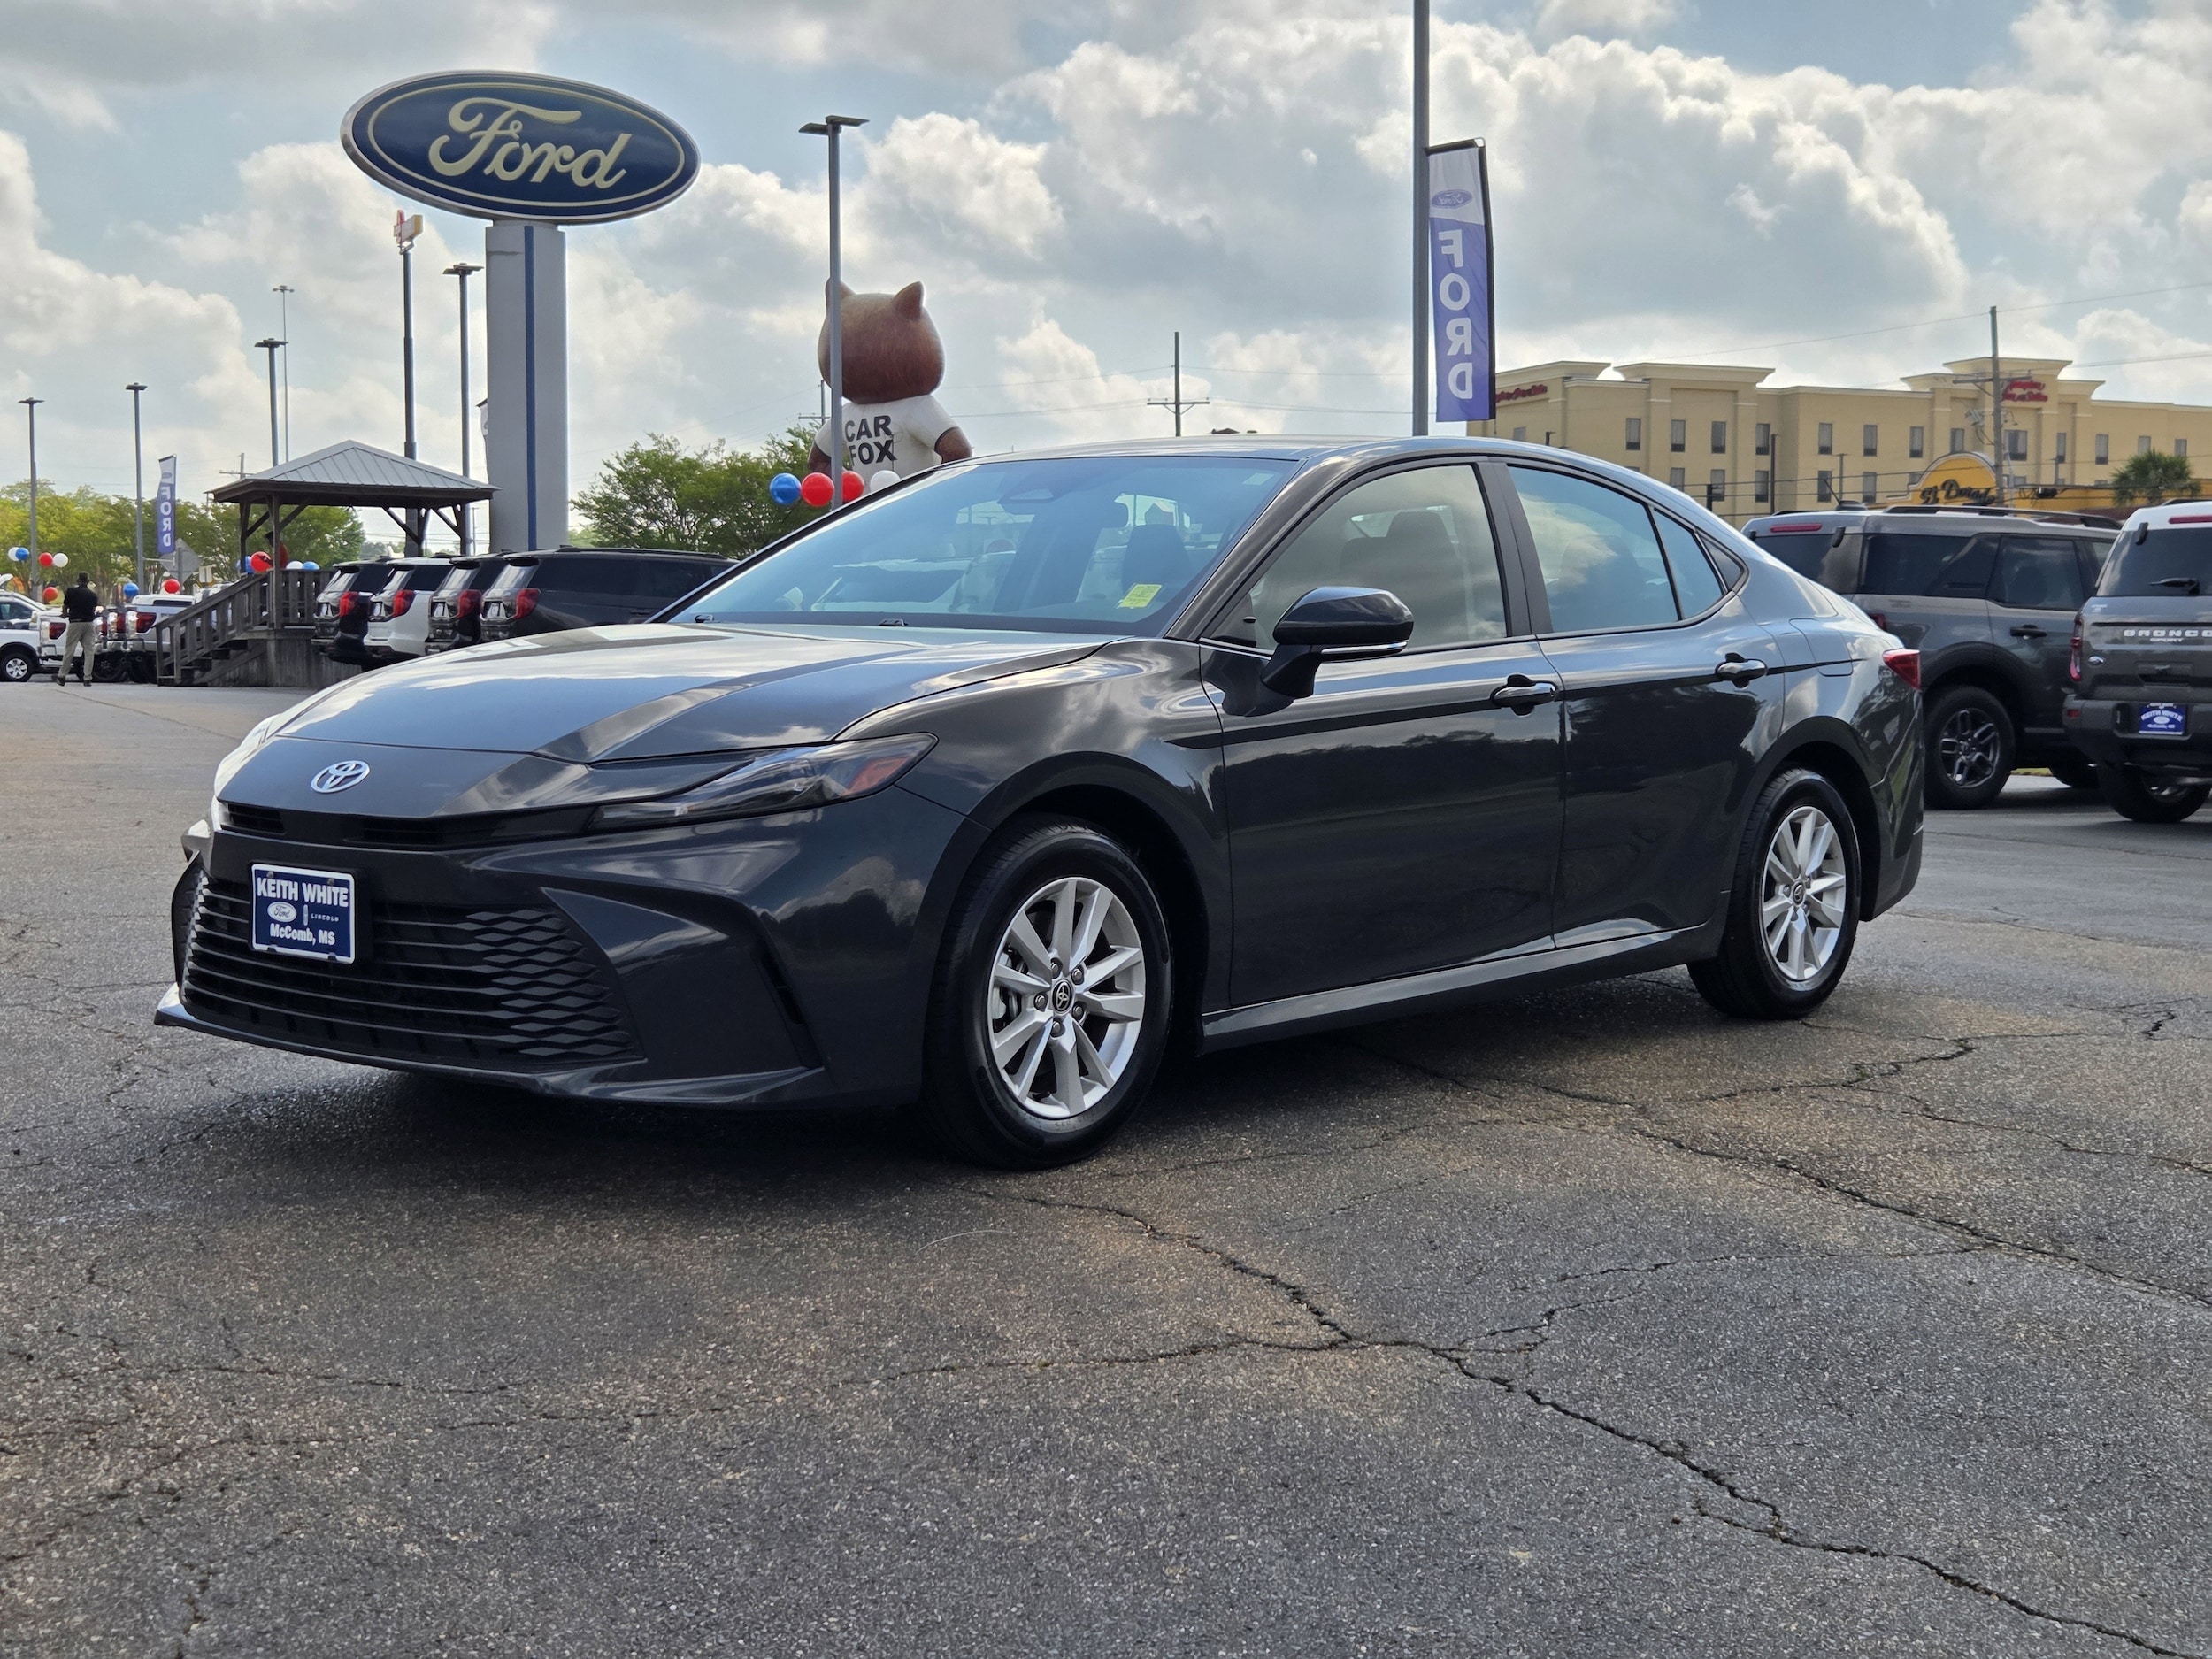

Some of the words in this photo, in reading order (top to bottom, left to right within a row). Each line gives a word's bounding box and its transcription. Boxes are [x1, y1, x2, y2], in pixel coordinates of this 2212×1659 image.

[427, 96, 633, 189] Ford
[844, 415, 893, 442] CAR
[849, 439, 898, 466] FOX
[257, 877, 298, 901] KEITH
[302, 882, 349, 908] WHITE
[273, 904, 291, 918] Ford
[311, 912, 340, 923] LINCOLN
[270, 922, 317, 946] McComb,
[318, 929, 336, 946] MS
